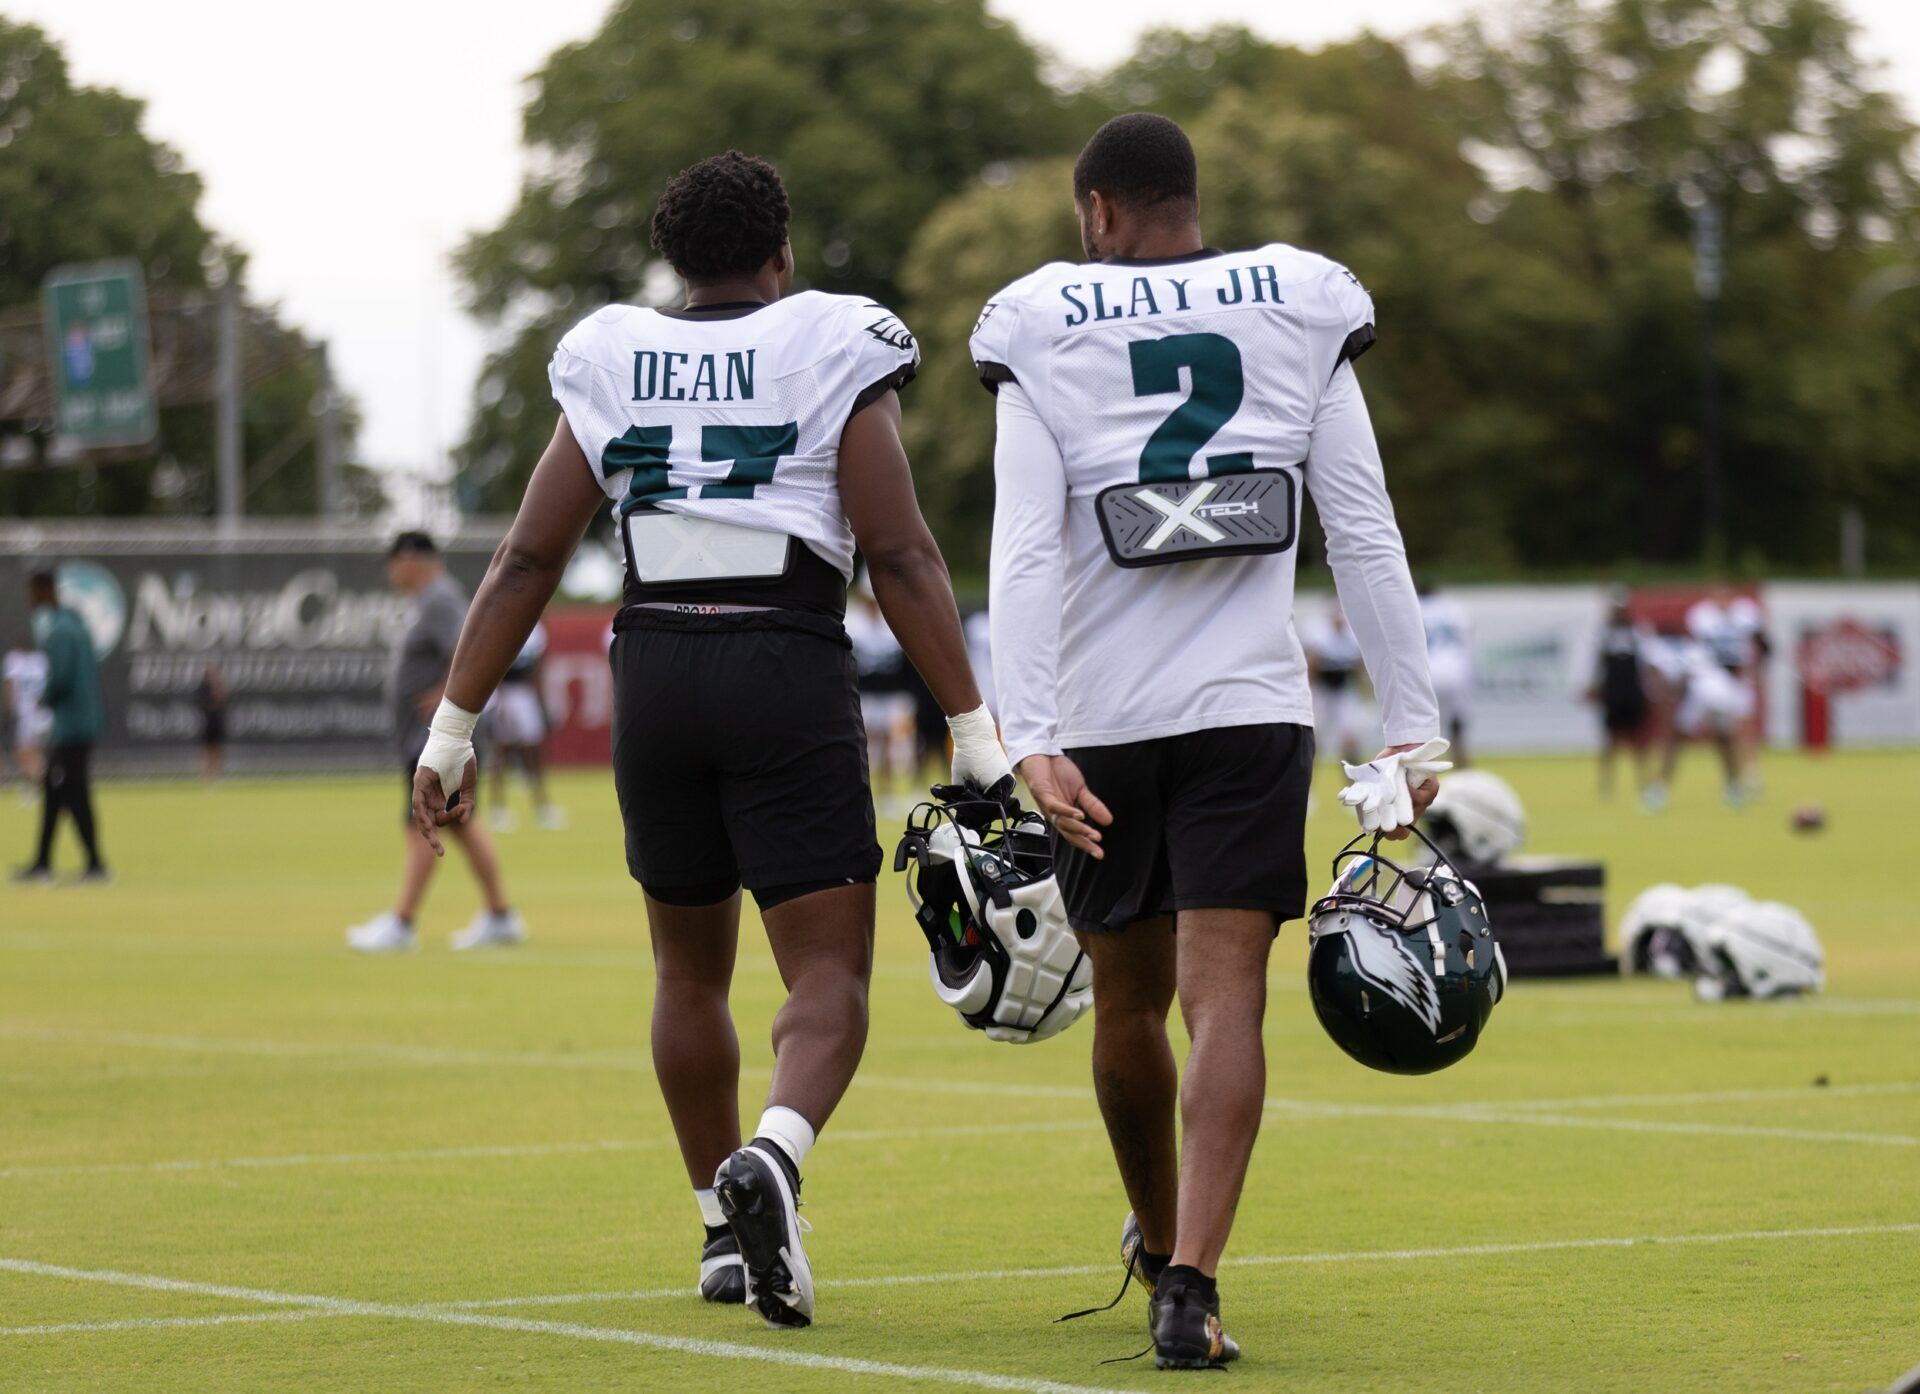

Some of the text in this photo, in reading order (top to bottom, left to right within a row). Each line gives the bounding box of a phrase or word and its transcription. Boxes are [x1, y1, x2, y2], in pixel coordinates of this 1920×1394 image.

[1060, 265, 1285, 327] SLAY JR
[632, 349, 756, 401] DEAN
[1128, 332, 1254, 484] 2
[601, 421, 799, 516] 17
